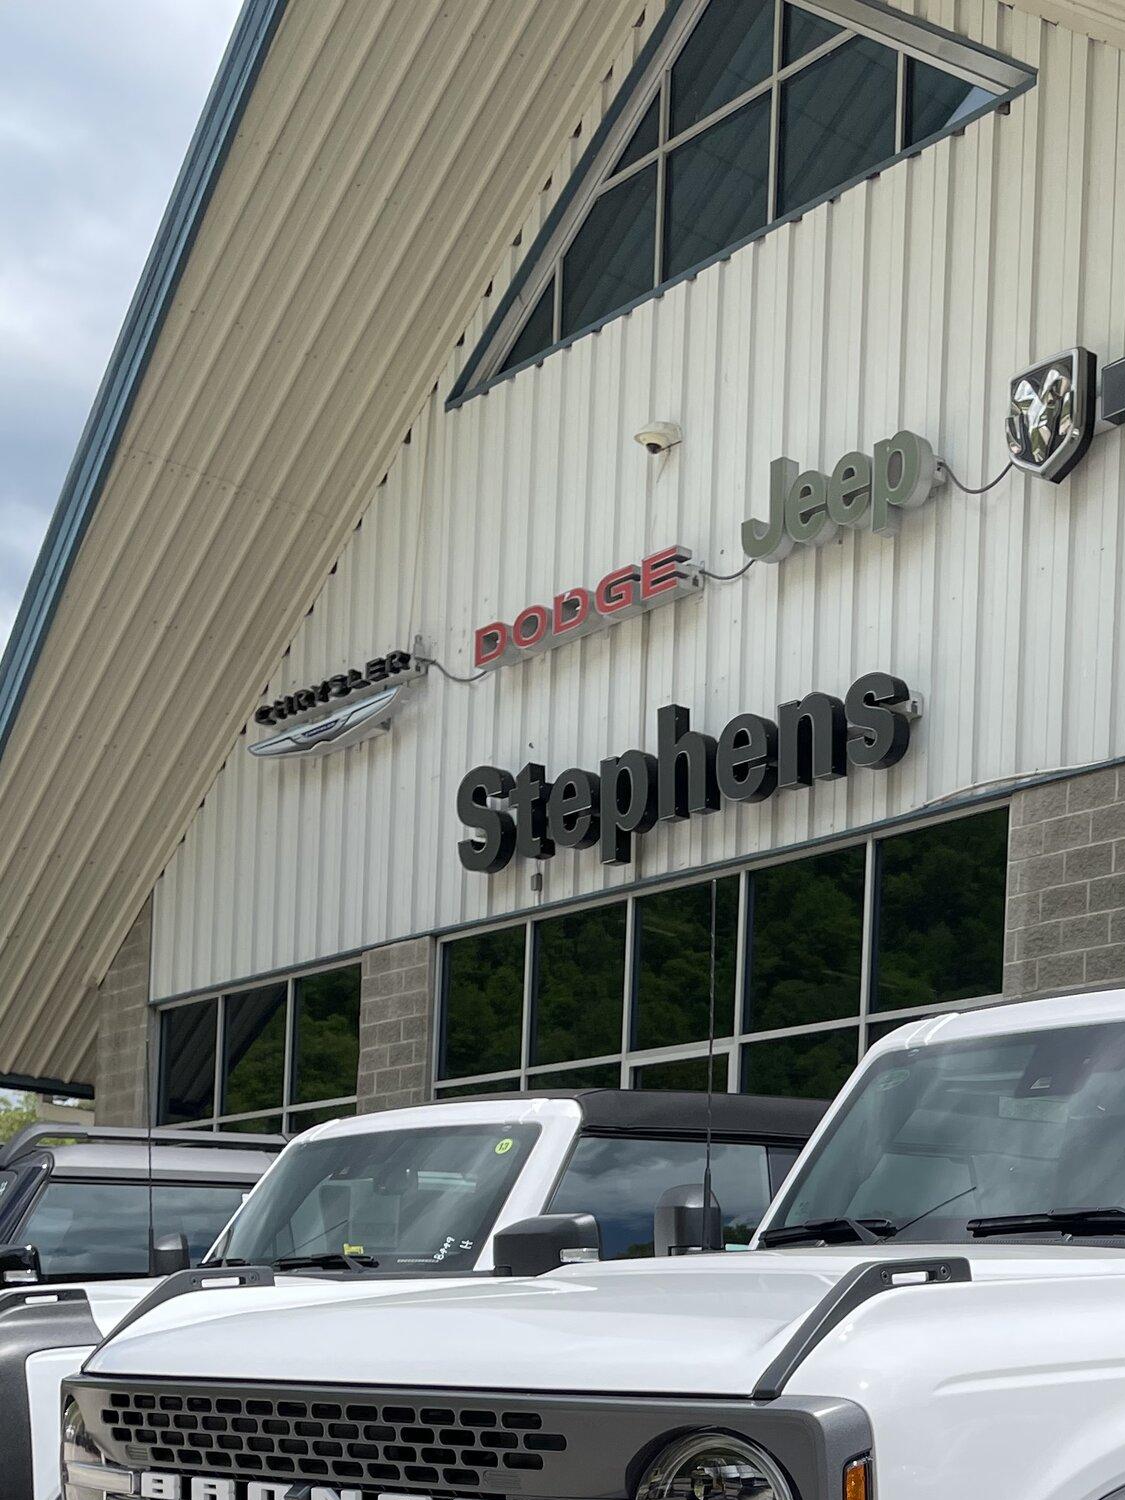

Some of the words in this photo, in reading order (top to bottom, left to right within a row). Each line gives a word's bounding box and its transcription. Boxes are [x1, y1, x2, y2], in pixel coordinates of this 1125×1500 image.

[740, 429, 935, 564] Jeep
[474, 545, 692, 671] DODGE
[254, 650, 411, 725] CHRYSLER
[456, 671, 911, 874] Stephens
